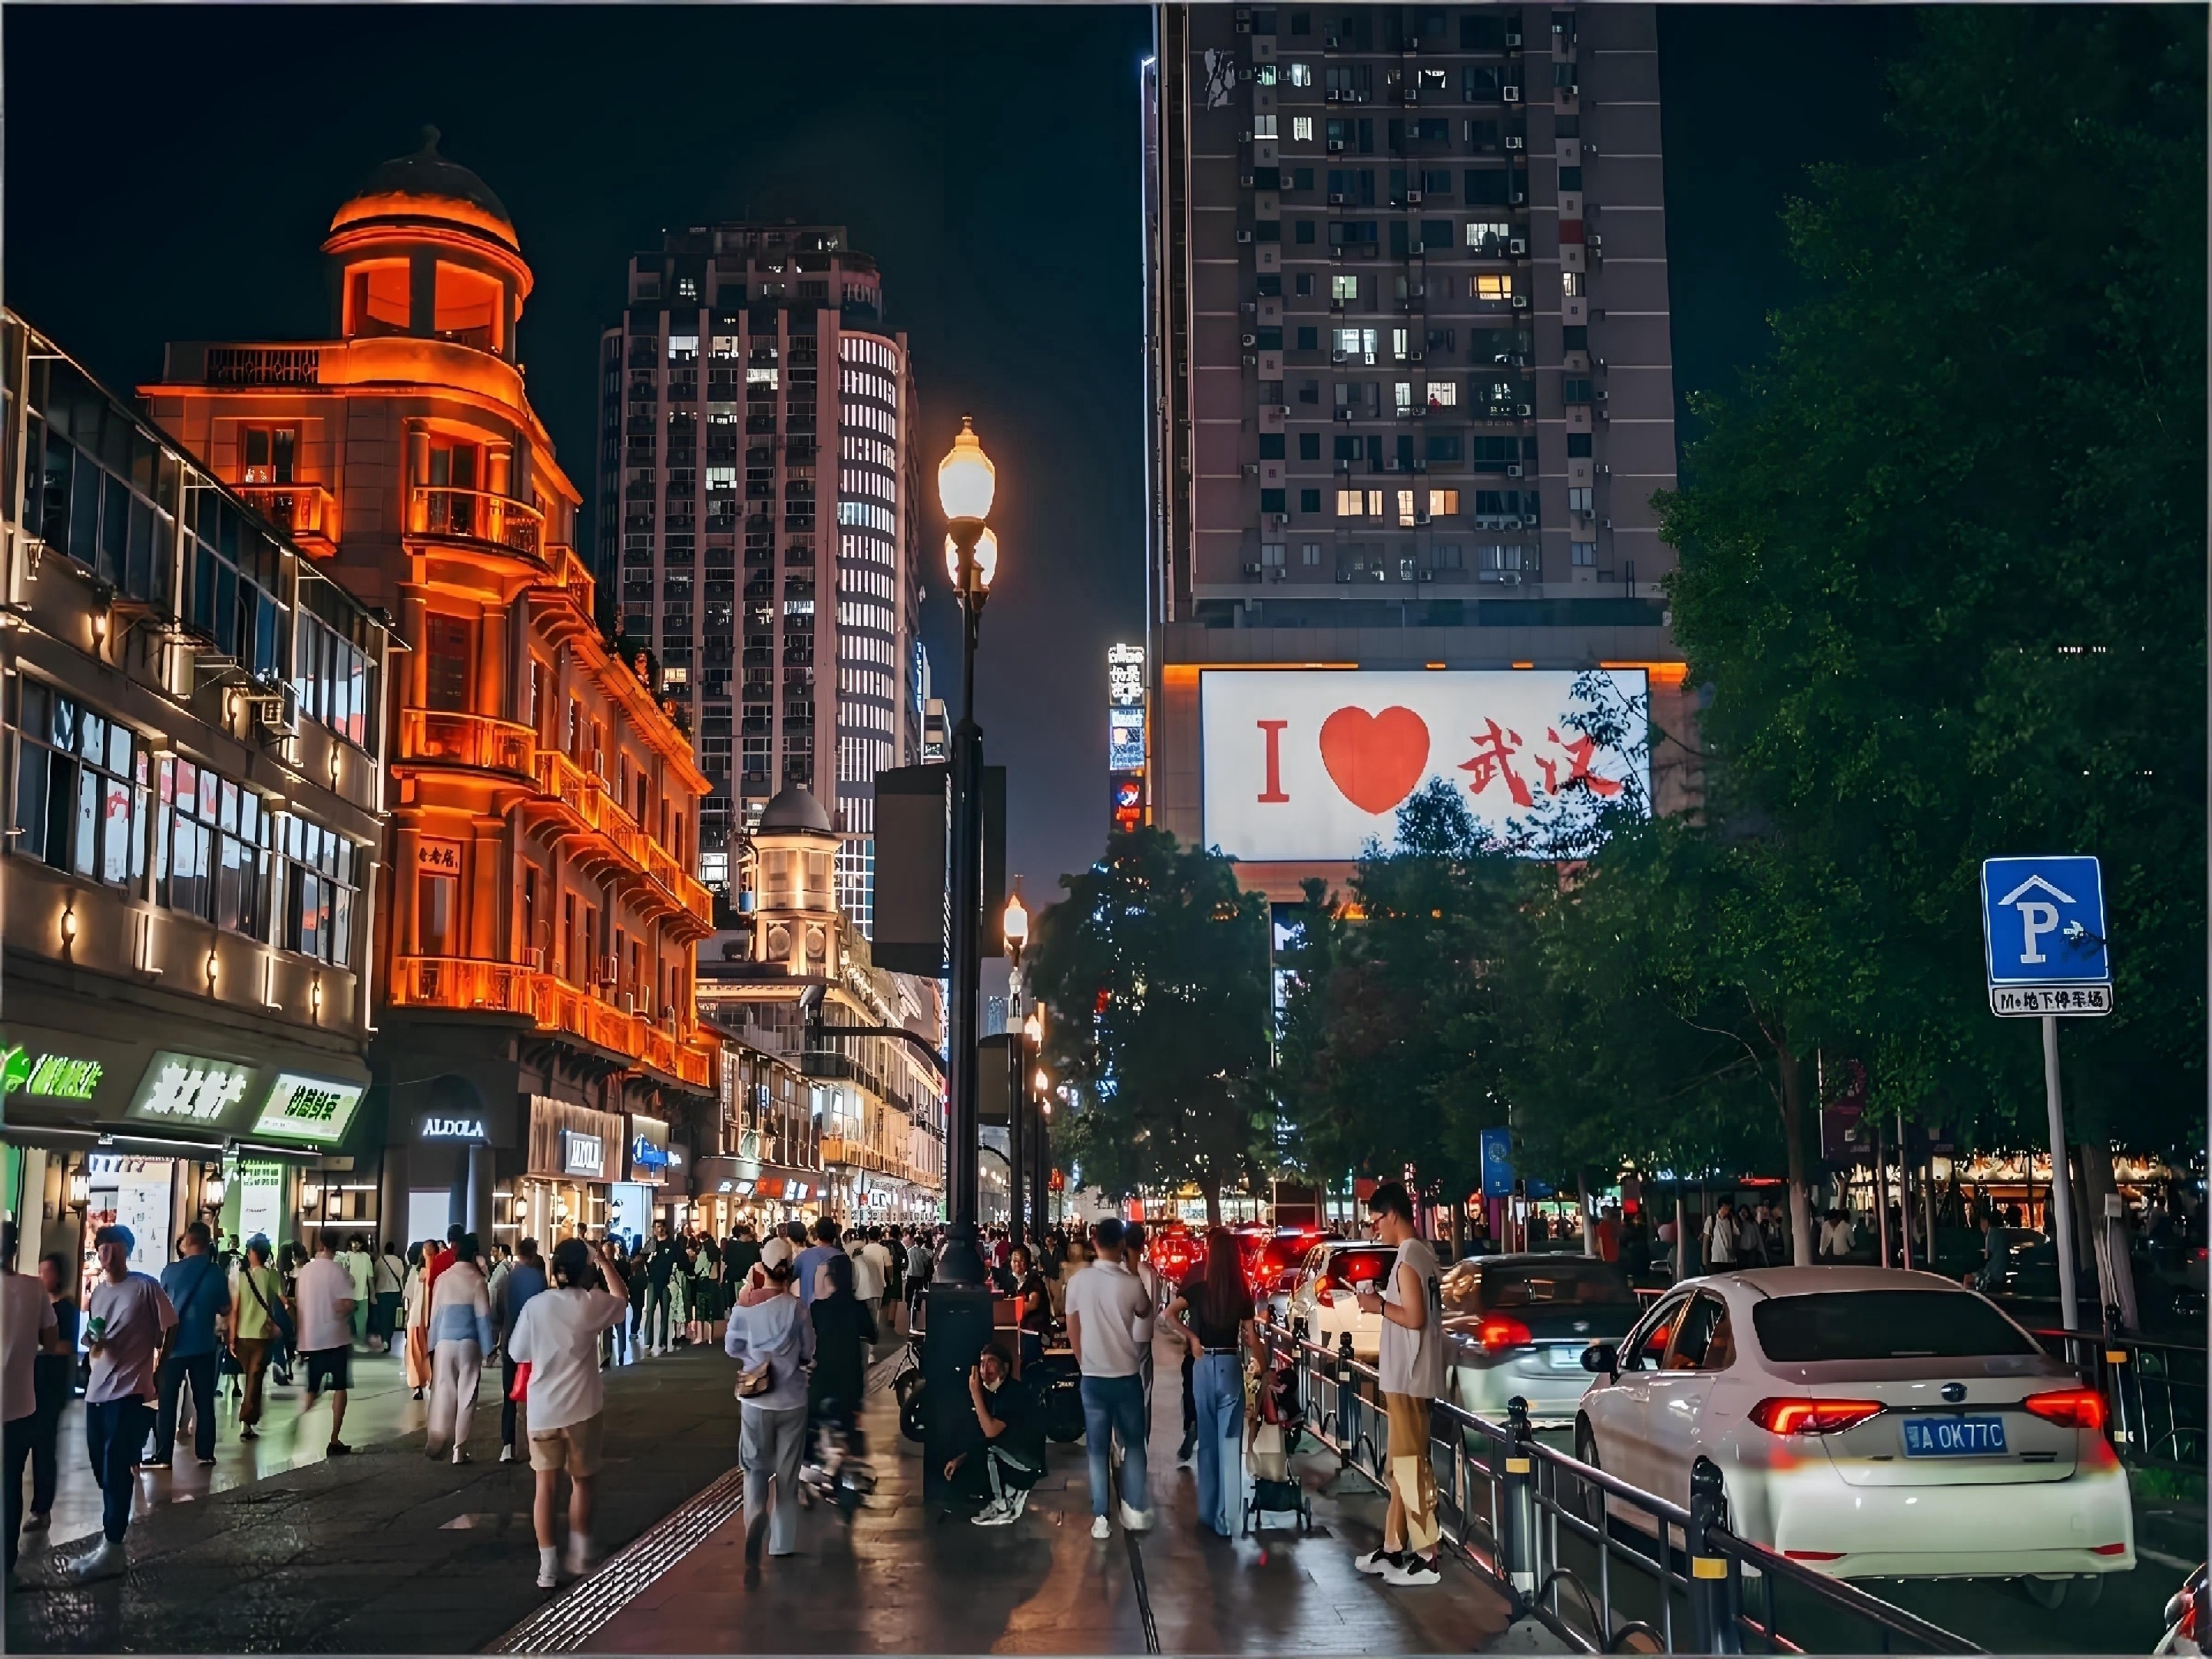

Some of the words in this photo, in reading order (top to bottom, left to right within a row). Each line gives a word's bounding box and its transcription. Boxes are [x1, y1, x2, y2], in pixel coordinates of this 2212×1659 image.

[1257, 720, 1289, 803] I
[1457, 717, 1623, 808] 武汉
[2016, 902, 2059, 963] P
